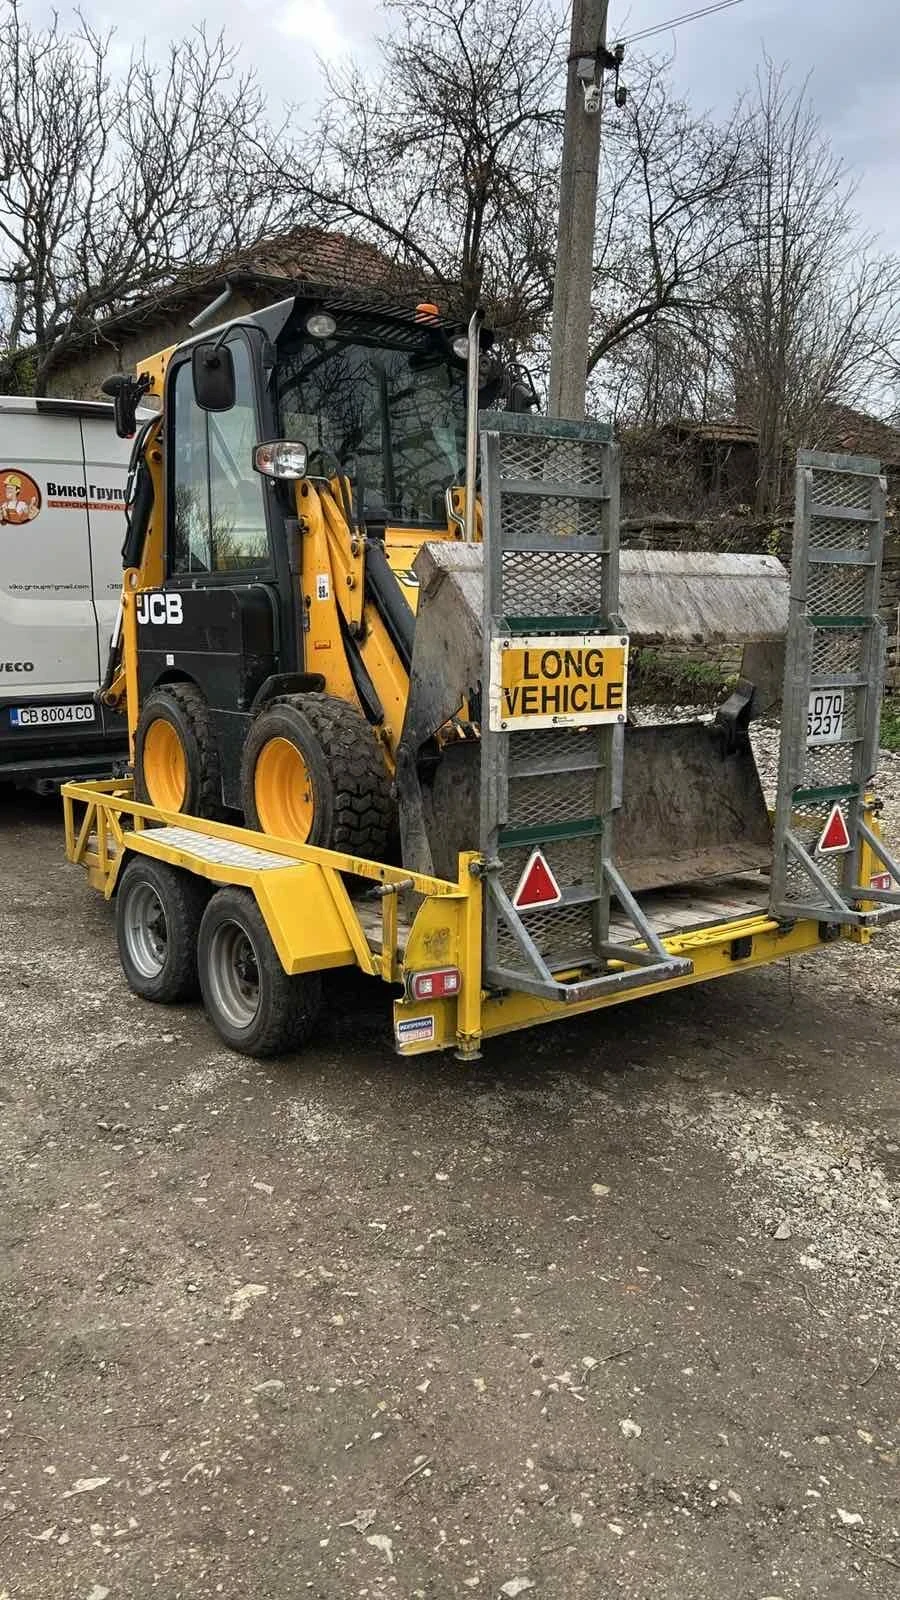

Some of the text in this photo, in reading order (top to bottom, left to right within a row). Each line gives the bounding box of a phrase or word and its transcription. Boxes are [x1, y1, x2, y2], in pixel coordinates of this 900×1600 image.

[47, 482, 86, 497] Вико
[136, 593, 183, 625] JCB
[523, 649, 604, 680] LONG
[504, 682, 623, 715] VEHICLE
[808, 695, 842, 716] 070
[20, 705, 92, 723] CB 8004 CO
